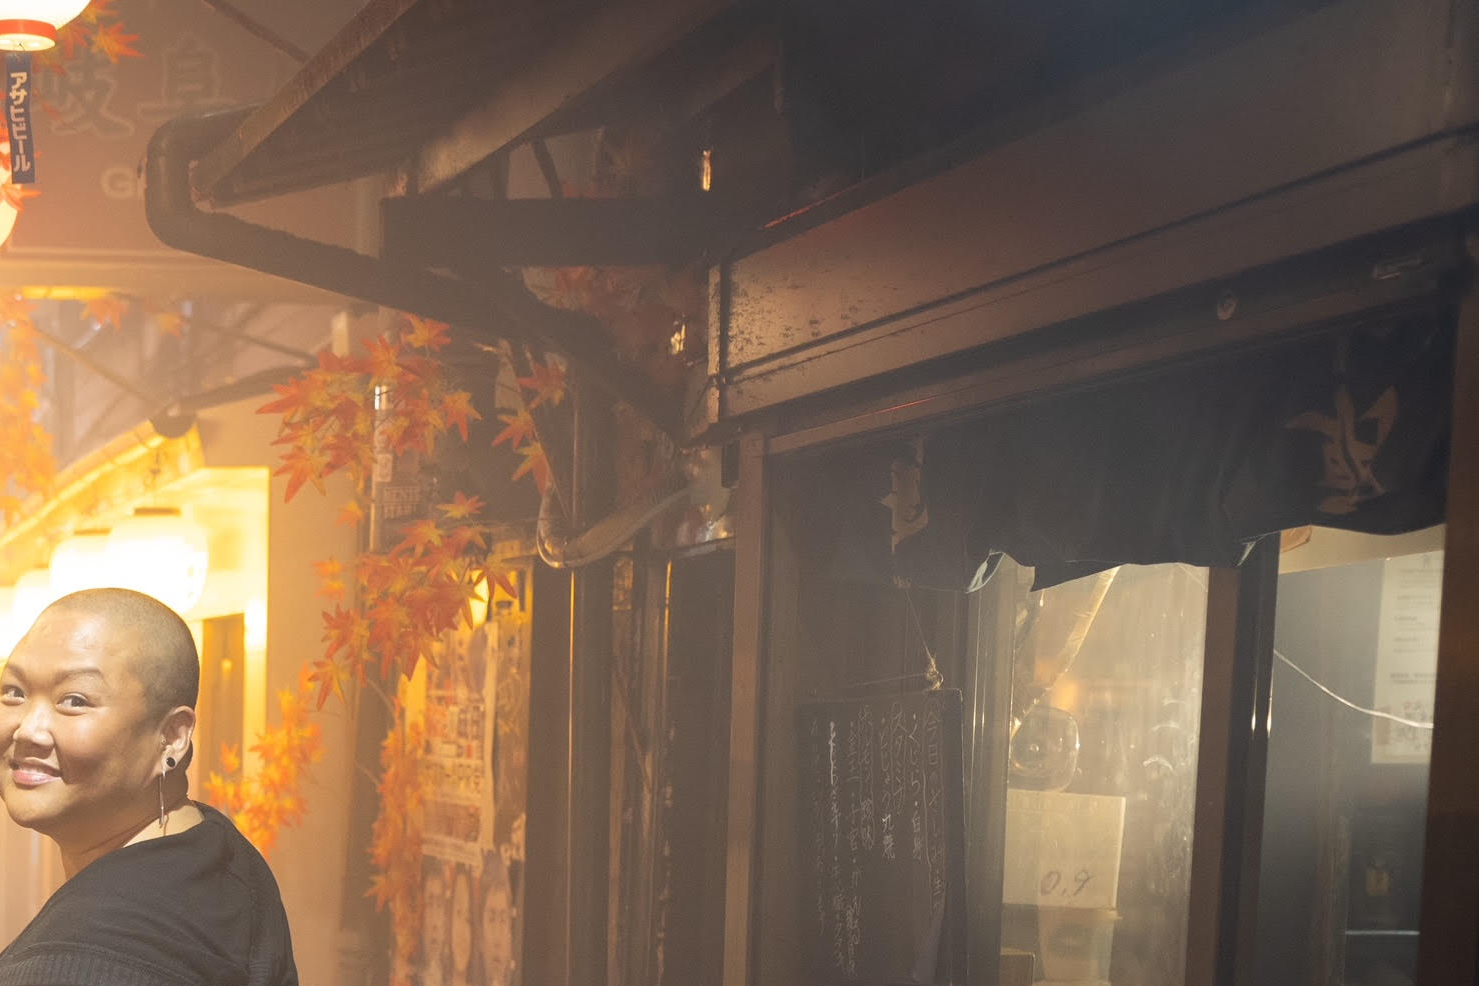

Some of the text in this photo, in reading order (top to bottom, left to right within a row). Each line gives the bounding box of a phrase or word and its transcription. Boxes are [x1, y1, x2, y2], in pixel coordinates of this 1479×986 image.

[9, 71, 31, 173] アサヒビール
